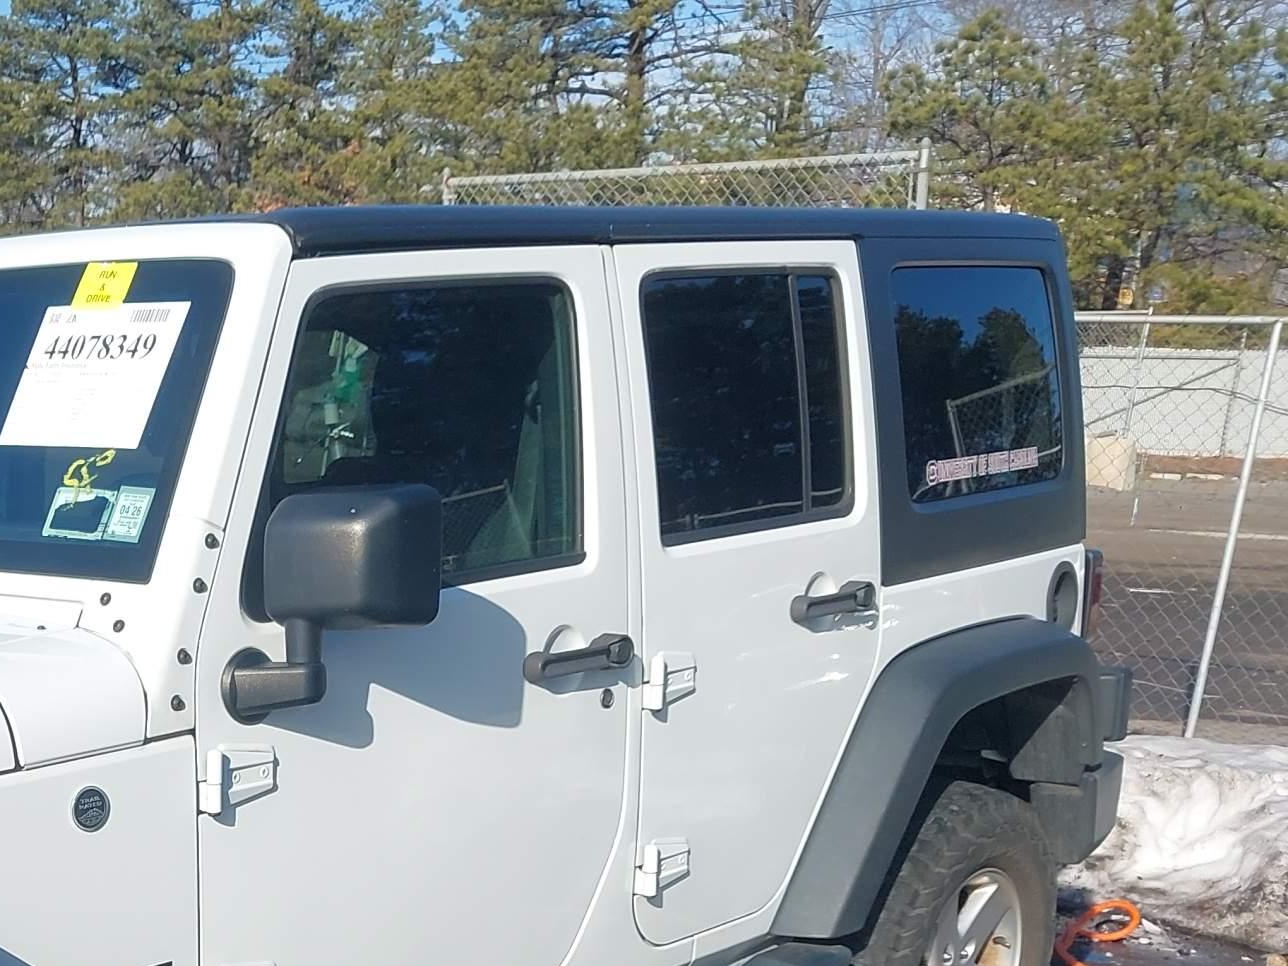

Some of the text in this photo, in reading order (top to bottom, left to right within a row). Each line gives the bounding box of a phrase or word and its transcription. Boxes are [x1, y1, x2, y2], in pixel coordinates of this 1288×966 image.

[98, 270, 118, 279] RUN
[86, 294, 111, 303] DRIVE
[44, 333, 158, 360] 44078349
[119, 504, 142, 516] 04 26
